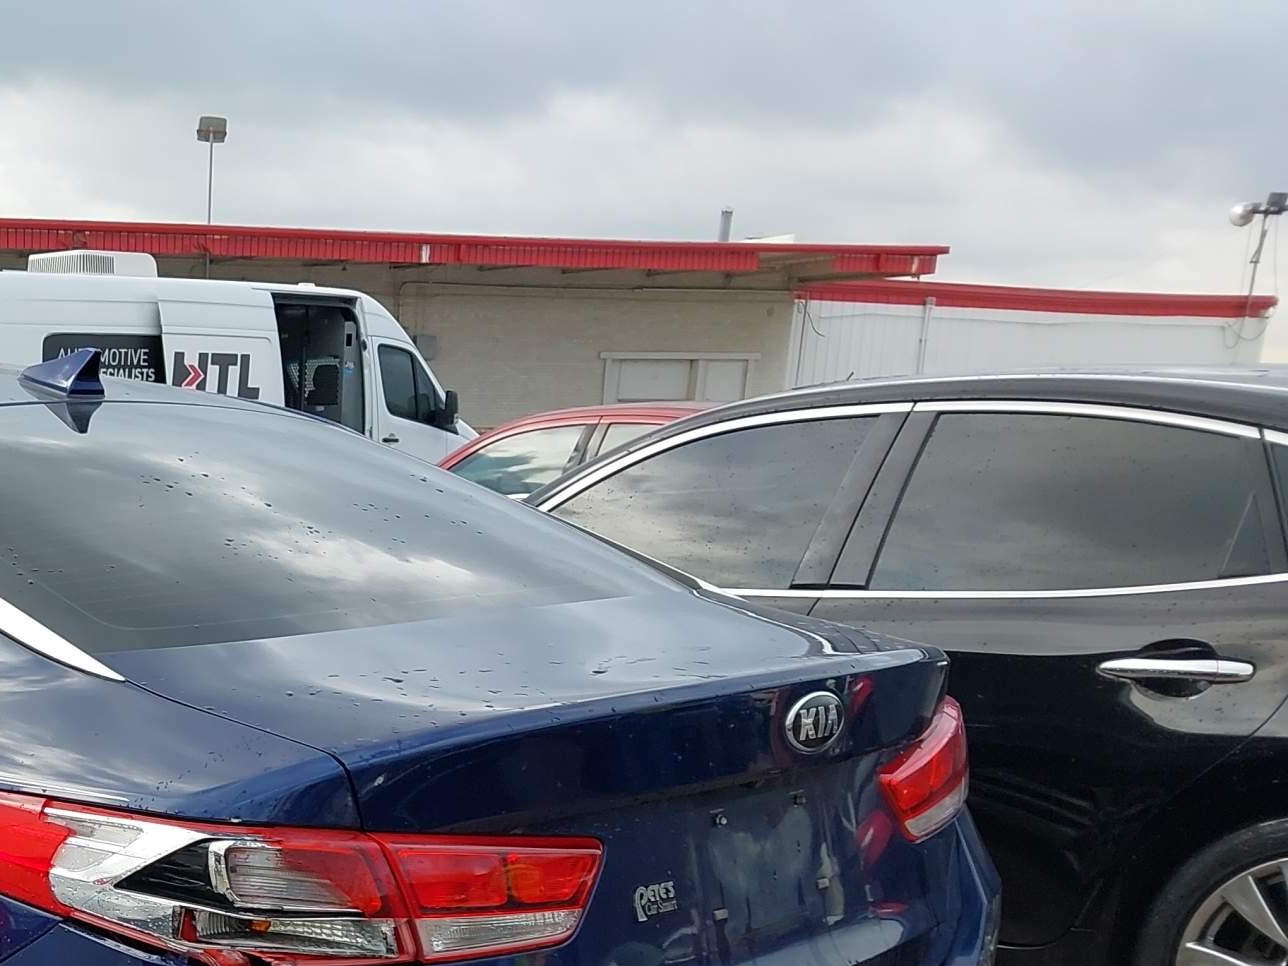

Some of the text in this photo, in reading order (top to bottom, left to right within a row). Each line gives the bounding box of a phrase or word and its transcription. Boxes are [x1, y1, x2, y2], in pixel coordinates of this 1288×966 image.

[58, 347, 149, 366] AMOTIVE
[100, 367, 155, 382] ECIALISTS
[171, 351, 260, 400] HTL
[799, 704, 838, 741] KIA
